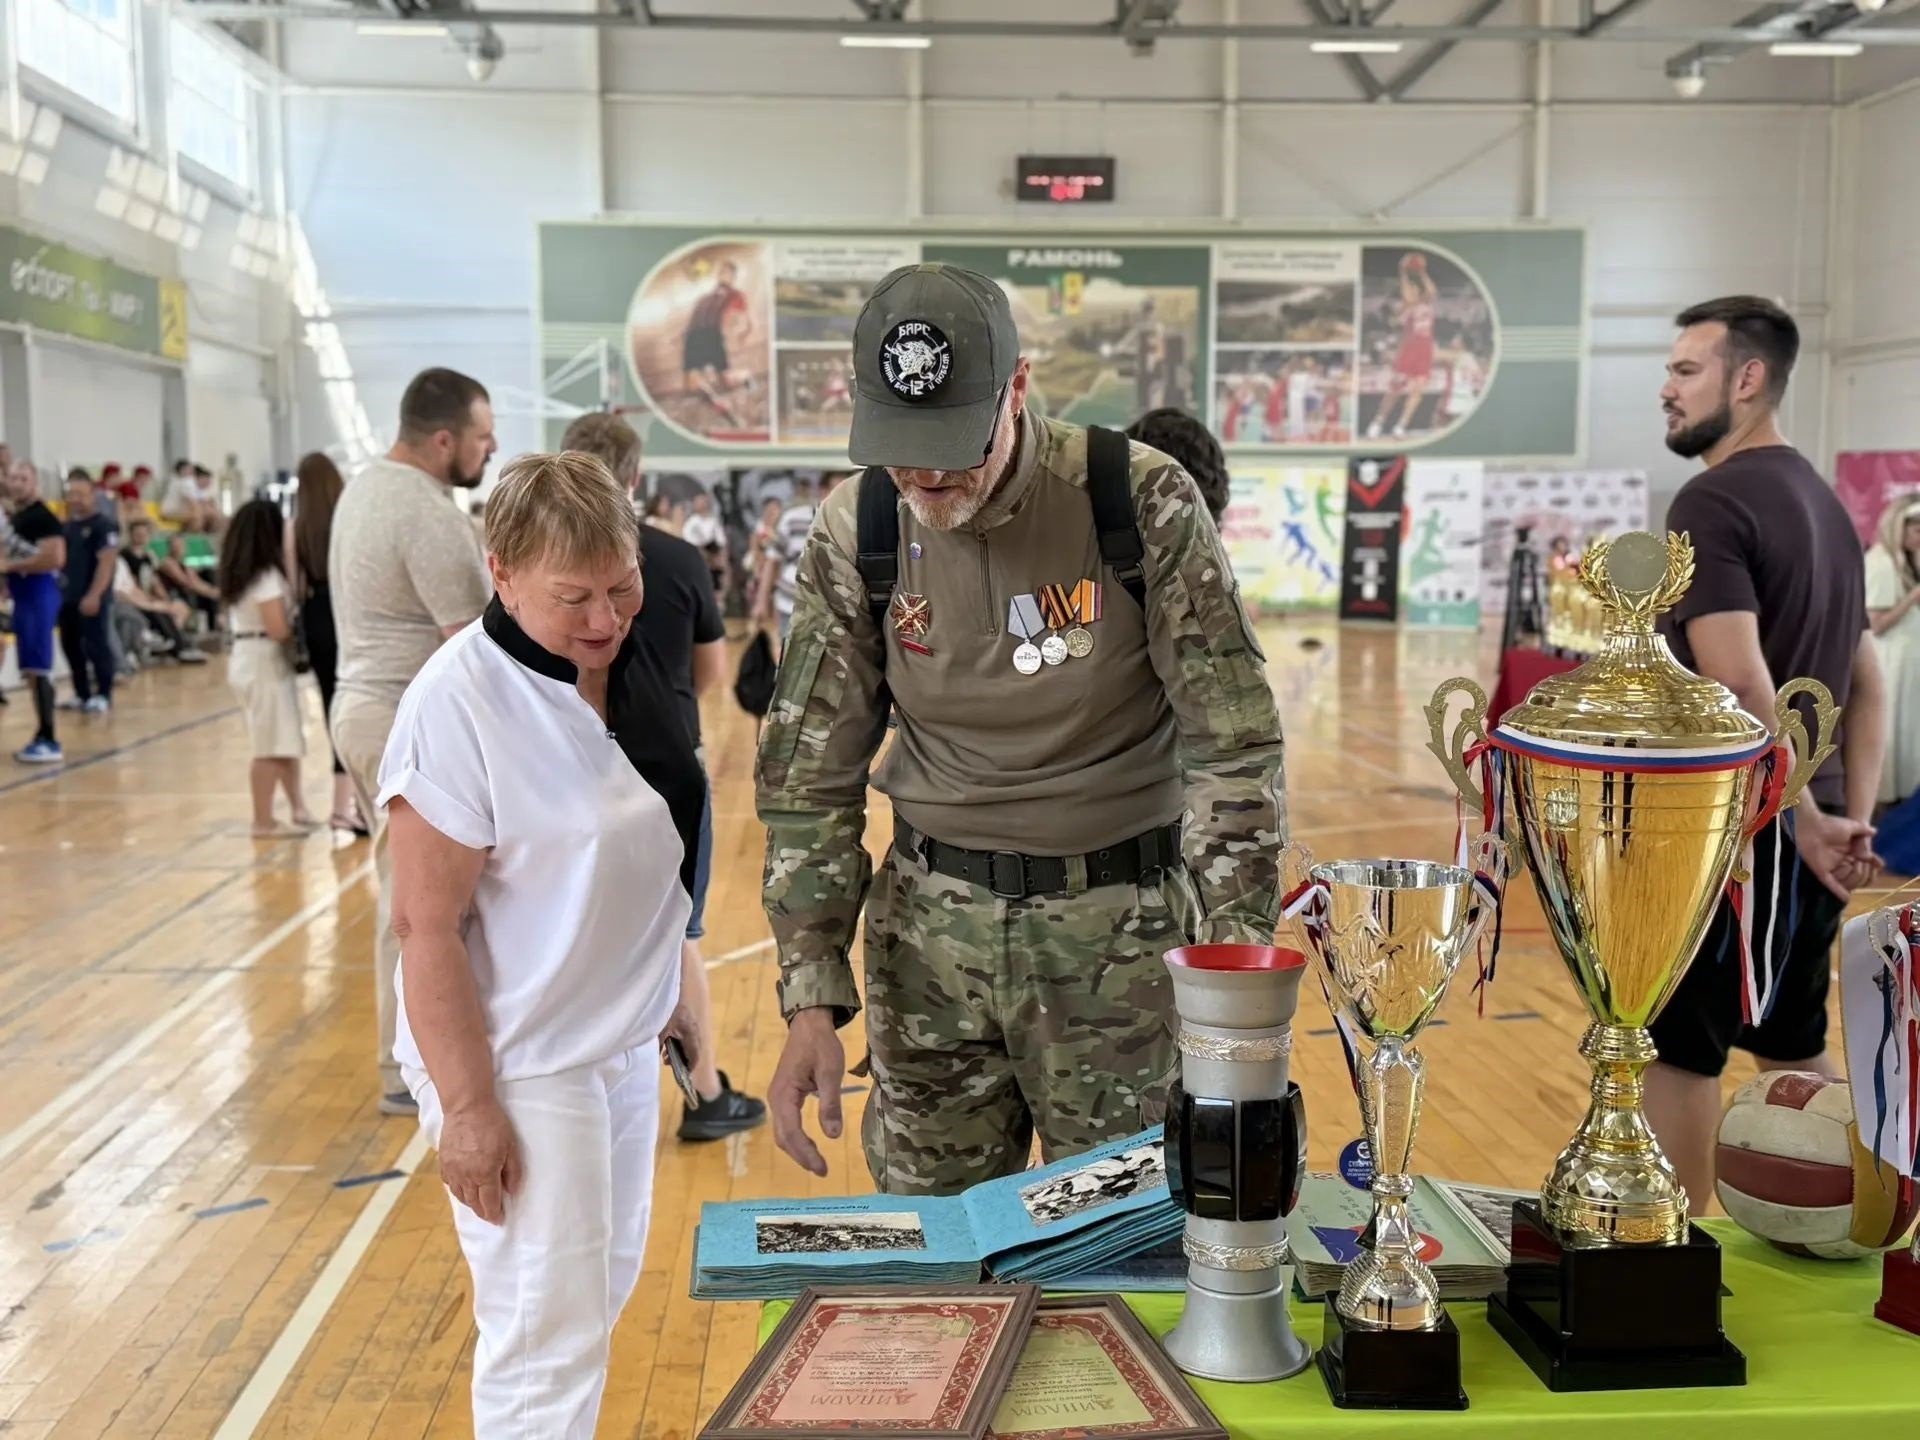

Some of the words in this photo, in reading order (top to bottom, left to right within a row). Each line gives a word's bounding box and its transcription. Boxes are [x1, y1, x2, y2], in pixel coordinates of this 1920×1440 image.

[1007, 250, 1123, 267] РАМОНЬ
[898, 323, 931, 337] БАРС
[910, 379, 925, 396] 12
